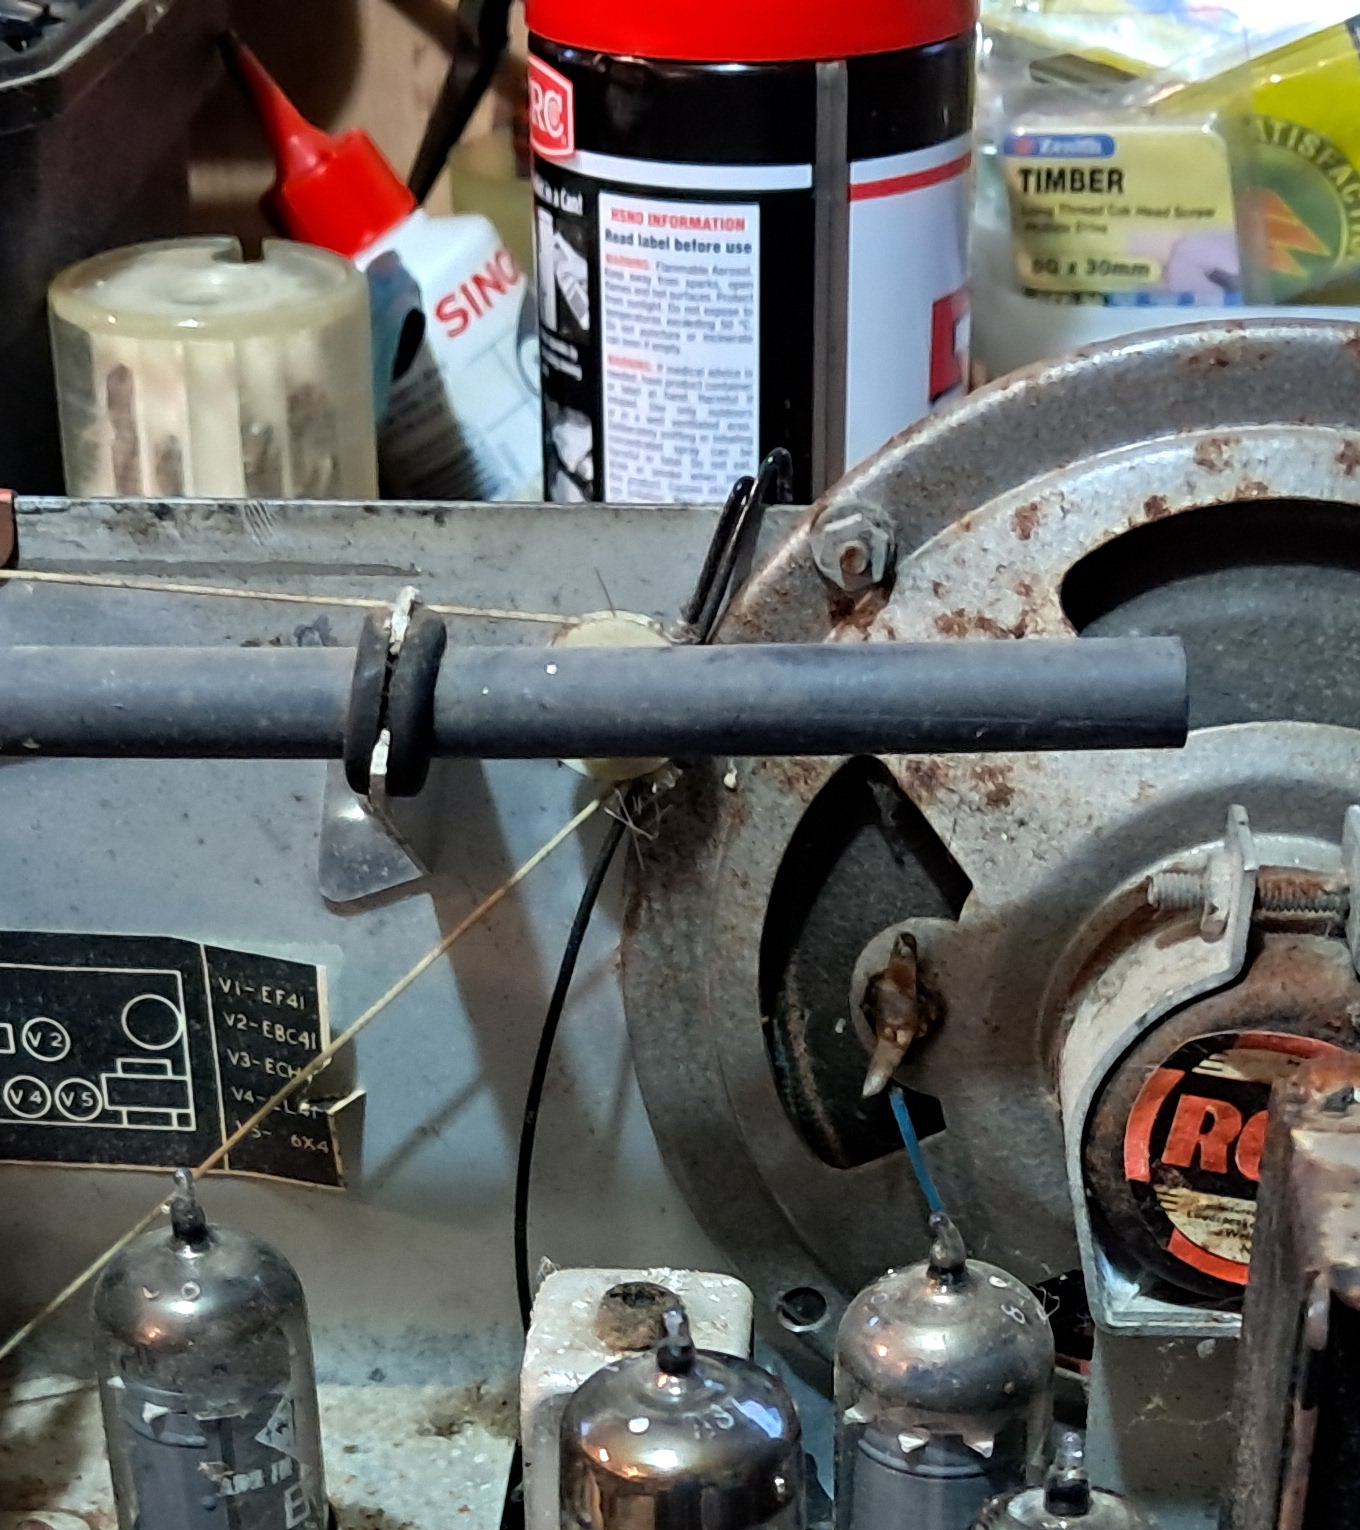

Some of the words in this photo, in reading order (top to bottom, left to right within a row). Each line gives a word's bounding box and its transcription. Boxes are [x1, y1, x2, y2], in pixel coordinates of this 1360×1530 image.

[1019, 167, 1125, 194] TIMBER
[648, 212, 746, 232] INFORMATION
[605, 227, 634, 246] Read
[638, 233, 670, 251] label
[674, 237, 722, 254] before
[725, 241, 753, 255] use
[290, 1133, 330, 1154] 6X4
